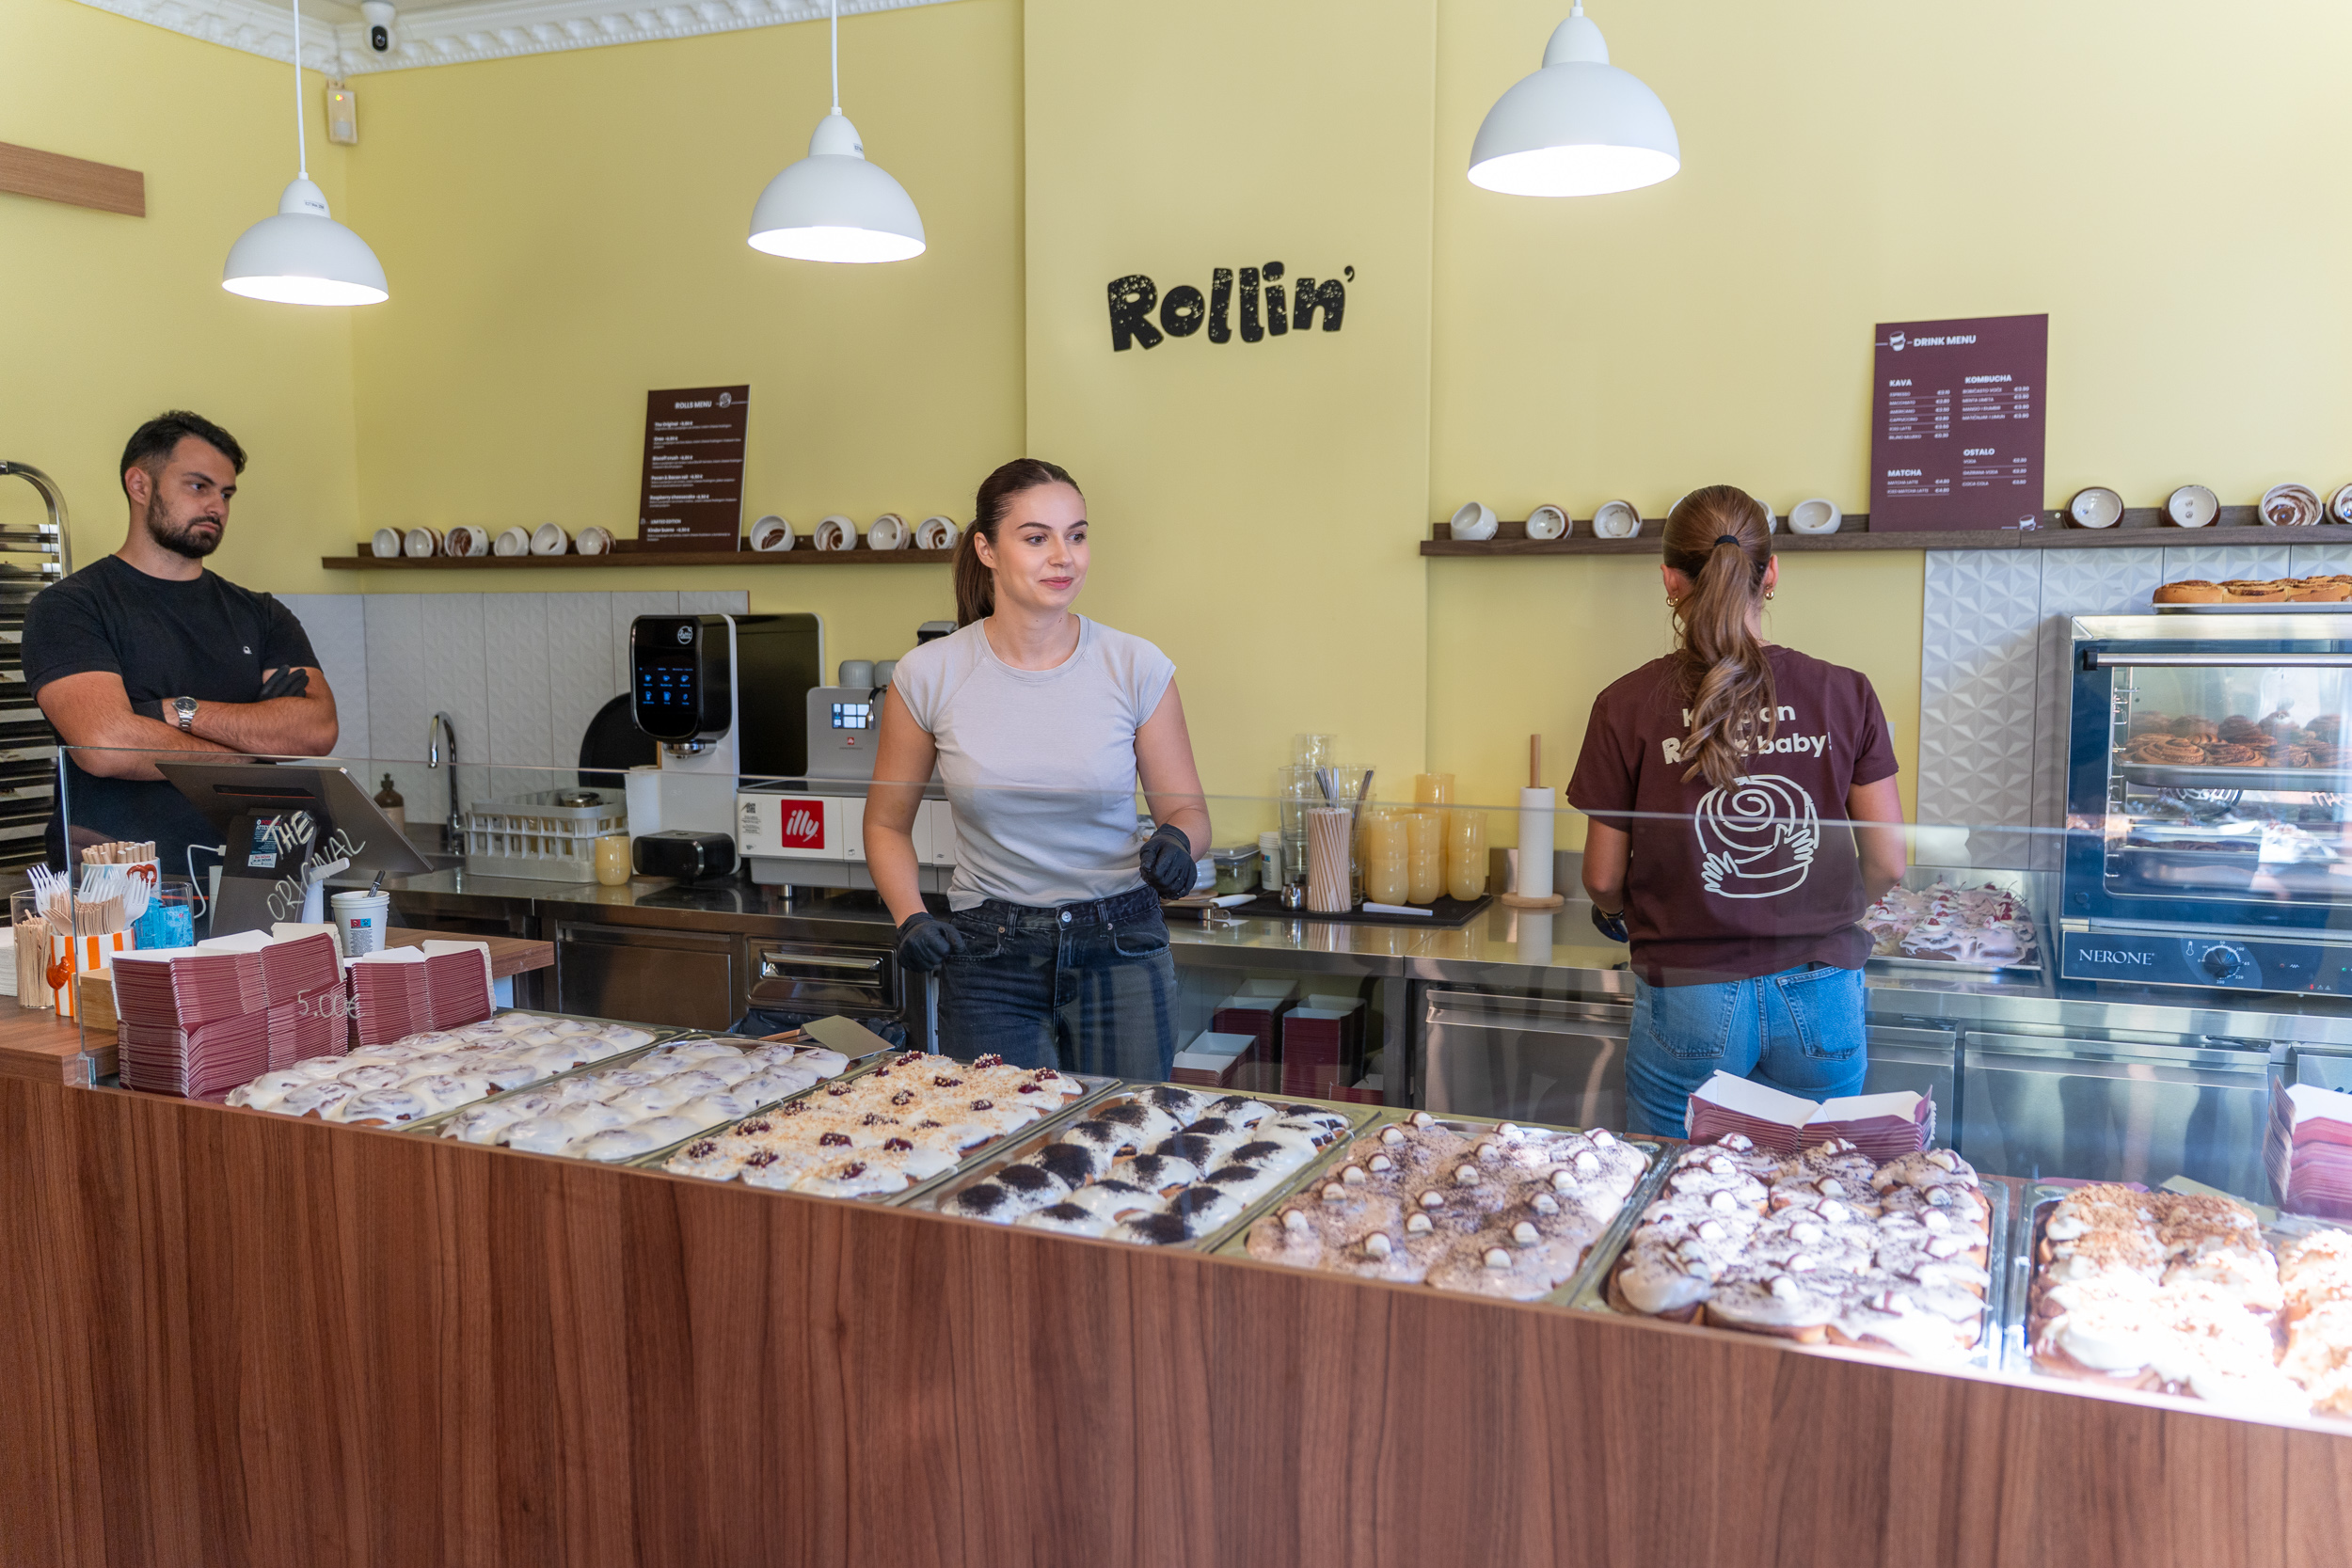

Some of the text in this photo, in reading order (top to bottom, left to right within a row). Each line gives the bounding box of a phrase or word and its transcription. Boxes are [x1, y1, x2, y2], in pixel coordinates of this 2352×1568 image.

[1914, 335, 1977, 347] DRINK MENU
[1965, 374, 2012, 384] KOMBUCHA
[1963, 448, 1994, 456] OSTALO
[1682, 705, 1796, 731] Kp on
[262, 810, 314, 860] THE
[786, 809, 819, 842] illy
